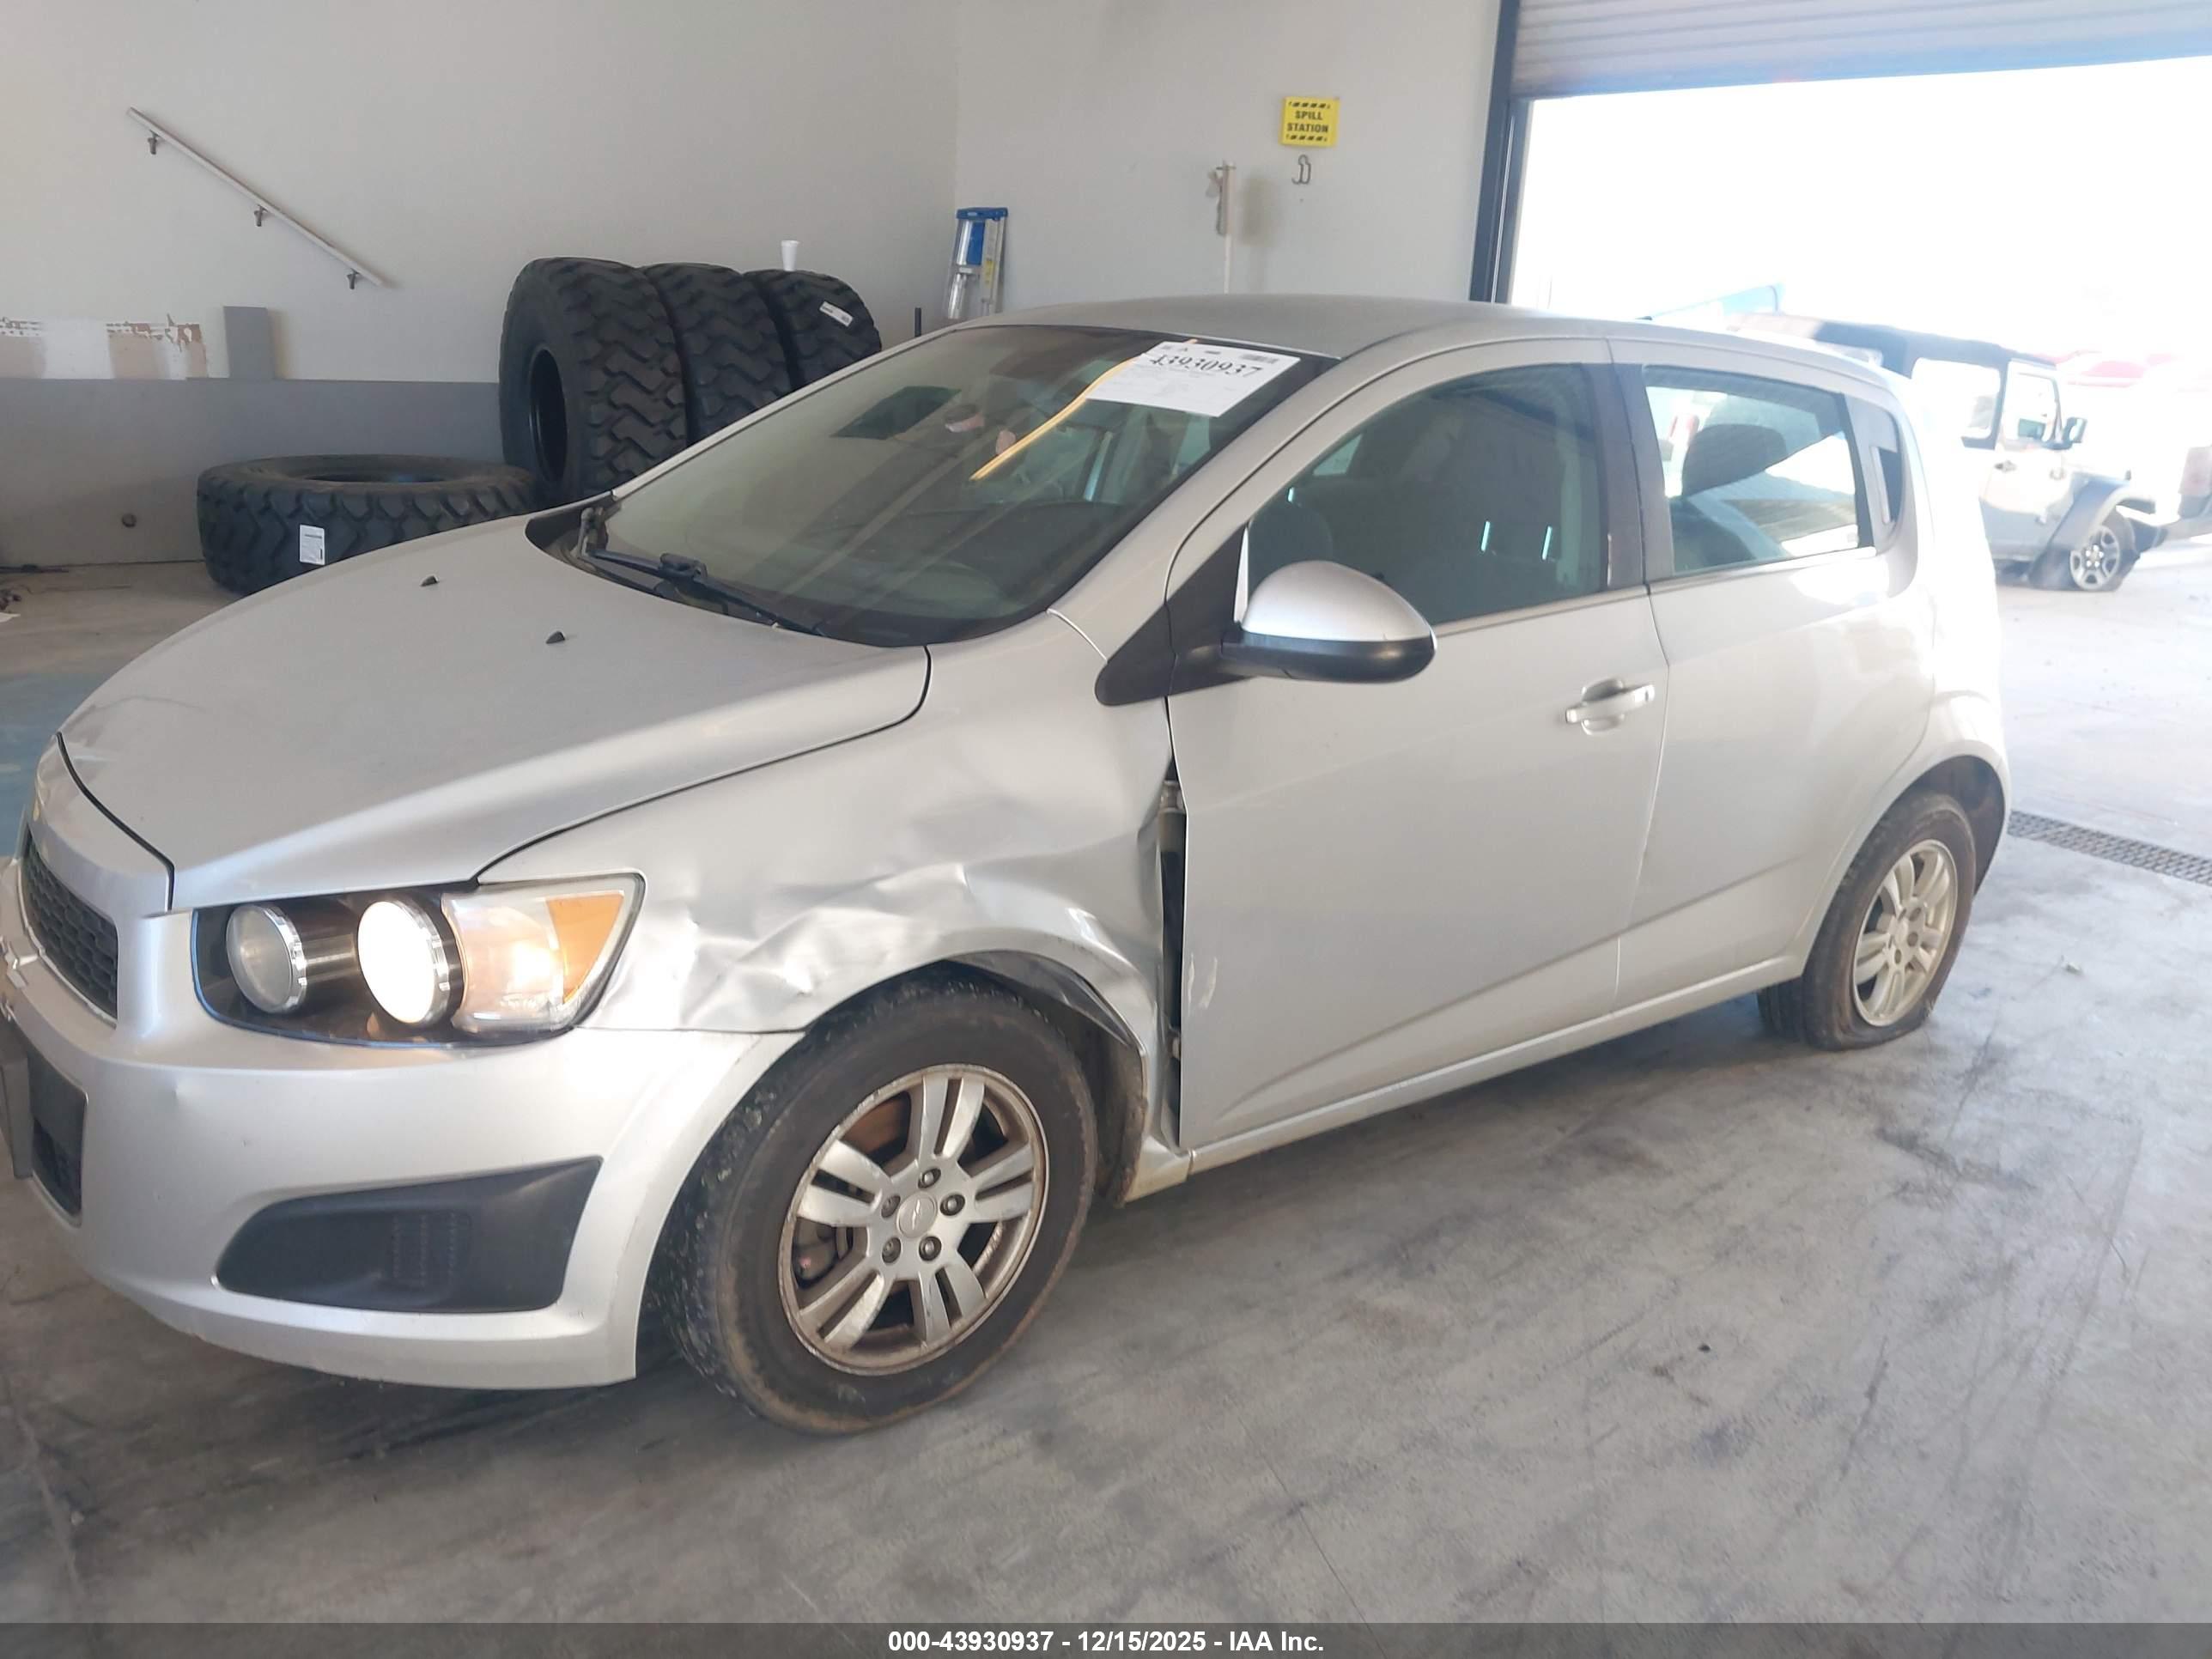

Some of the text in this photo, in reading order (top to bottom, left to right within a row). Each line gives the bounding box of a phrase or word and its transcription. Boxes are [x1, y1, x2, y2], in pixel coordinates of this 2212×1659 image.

[1295, 110, 1323, 120] SPILL
[1287, 123, 1329, 133] STATION
[1149, 354, 1262, 378] 43930937
